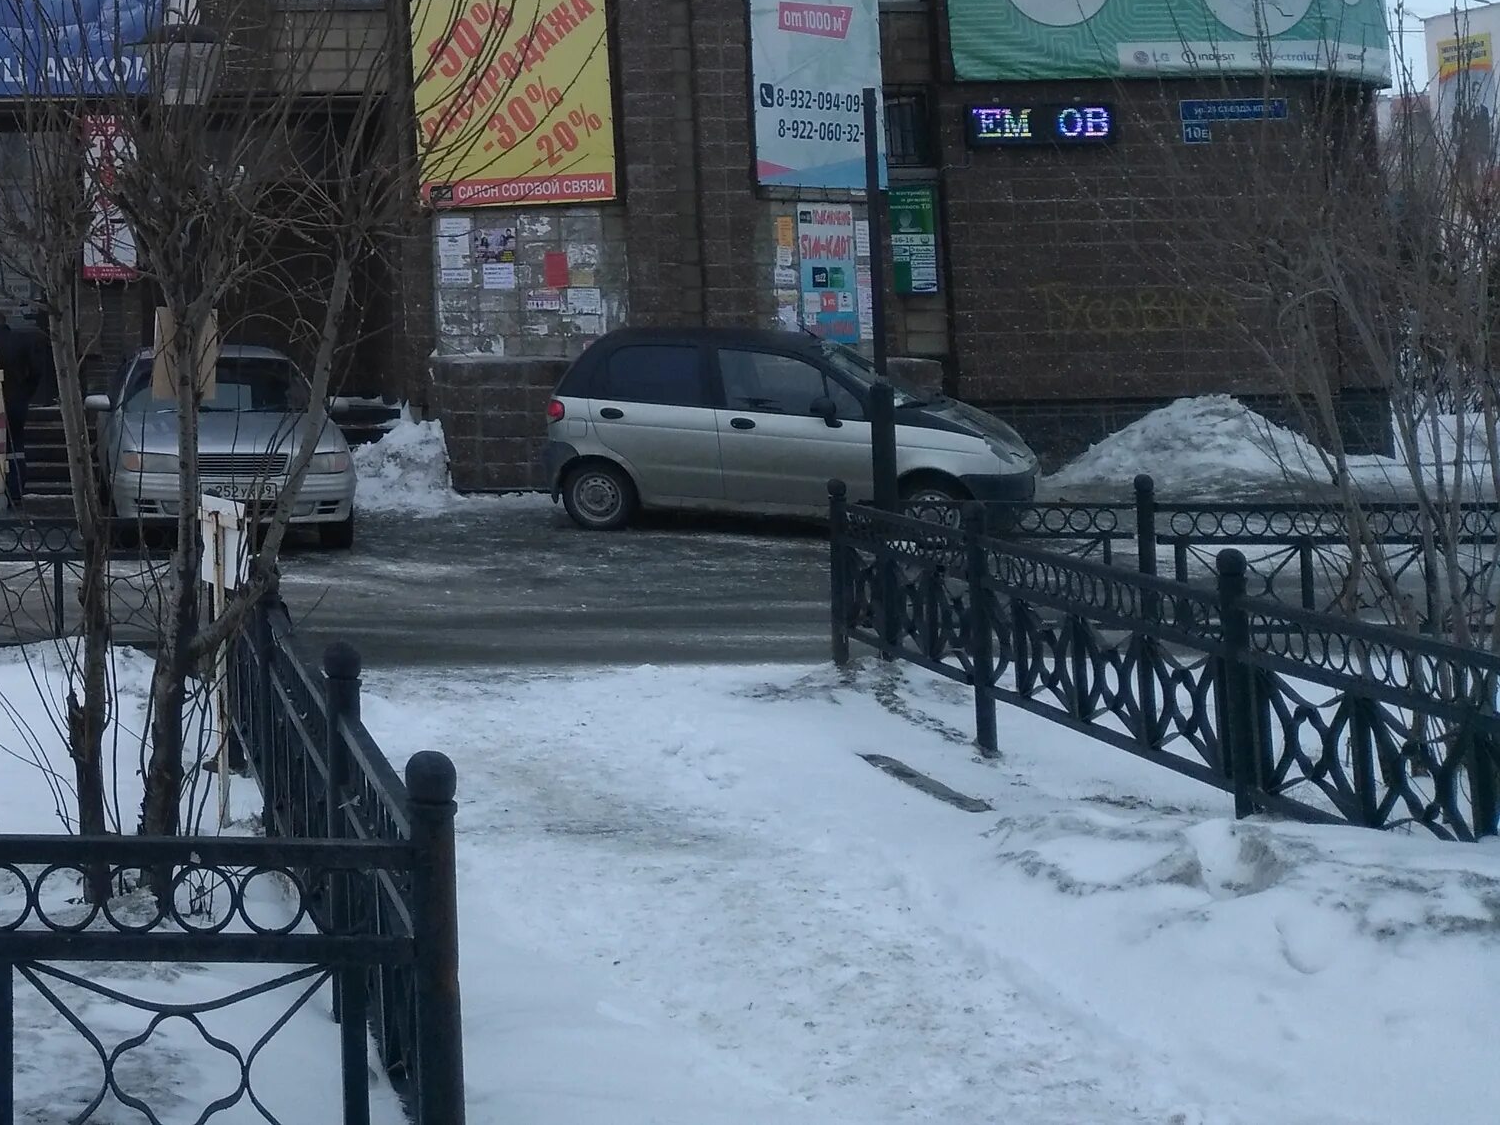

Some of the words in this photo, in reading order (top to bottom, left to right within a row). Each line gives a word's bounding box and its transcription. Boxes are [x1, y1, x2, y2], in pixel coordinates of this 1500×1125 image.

[804, 10, 831, 31] 1000
[1265, 51, 1318, 63] lectrolux
[776, 88, 865, 113] 8-932-094-09-
[483, 76, 564, 152] -30%
[533, 103, 602, 167] -20%
[778, 118, 864, 143] 8-922-060-32-
[458, 184, 499, 200] САЛОН
[502, 179, 560, 198] СОТОВОЙ
[563, 178, 605, 194] СВЯЗИ
